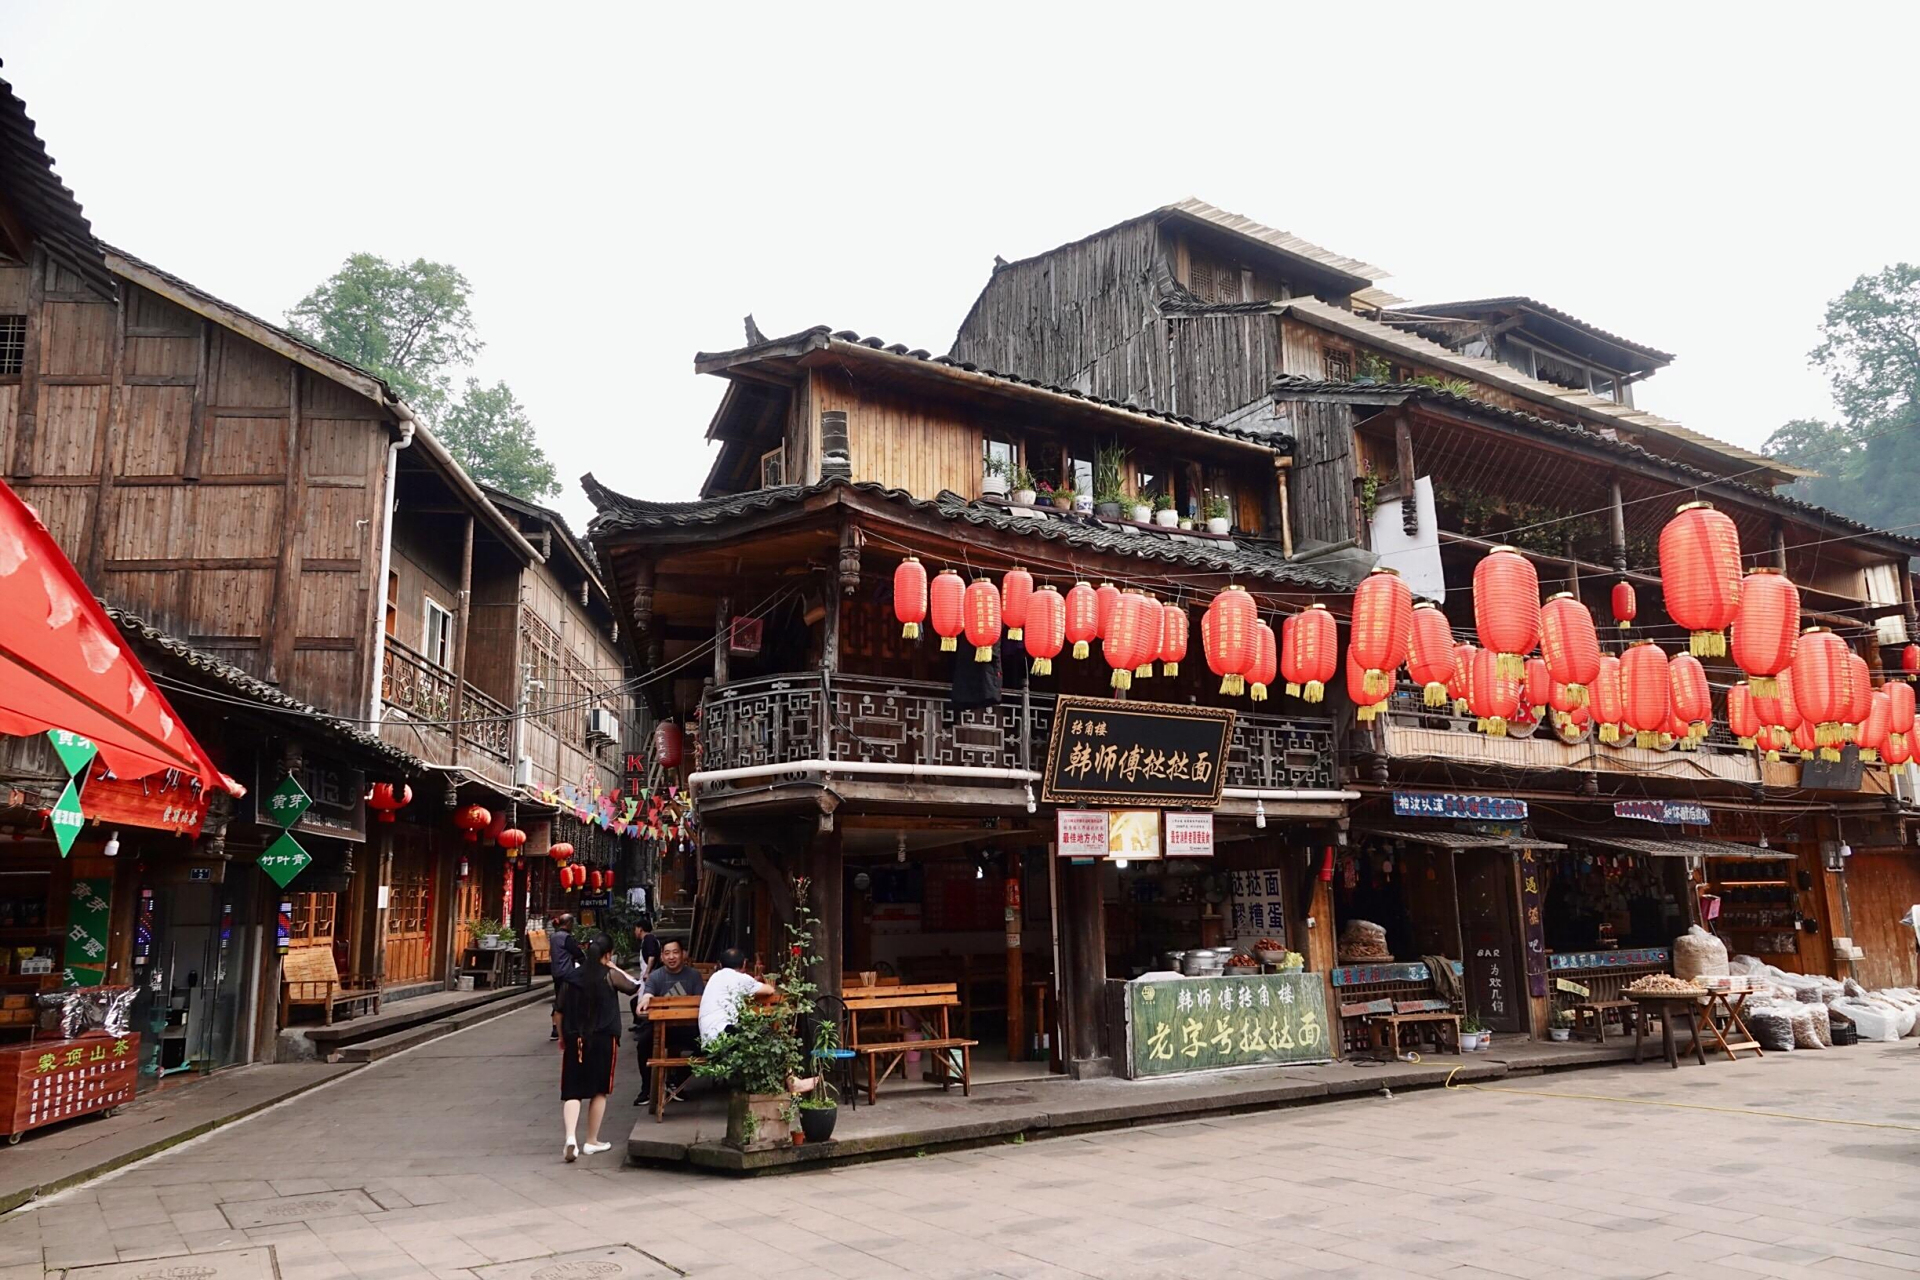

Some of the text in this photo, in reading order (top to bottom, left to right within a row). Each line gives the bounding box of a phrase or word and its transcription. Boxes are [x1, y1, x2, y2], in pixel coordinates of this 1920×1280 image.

[1070, 719, 1108, 737] 转角楼
[1064, 740, 1213, 783] 韩师傅挞挞面
[271, 794, 305, 810] 黄芽
[1062, 832, 1105, 845] 最佳地方小吃
[261, 853, 306, 866] 竹叶青
[69, 924, 105, 957] 甘露
[1477, 949, 1500, 957] BAR
[1177, 982, 1295, 1013] 韩师傅转角楼
[1489, 963, 1504, 1013] 为欢几何
[1147, 1011, 1320, 1060] 老字号挞挞面
[36, 1040, 129, 1073] 蒙顶山茶
